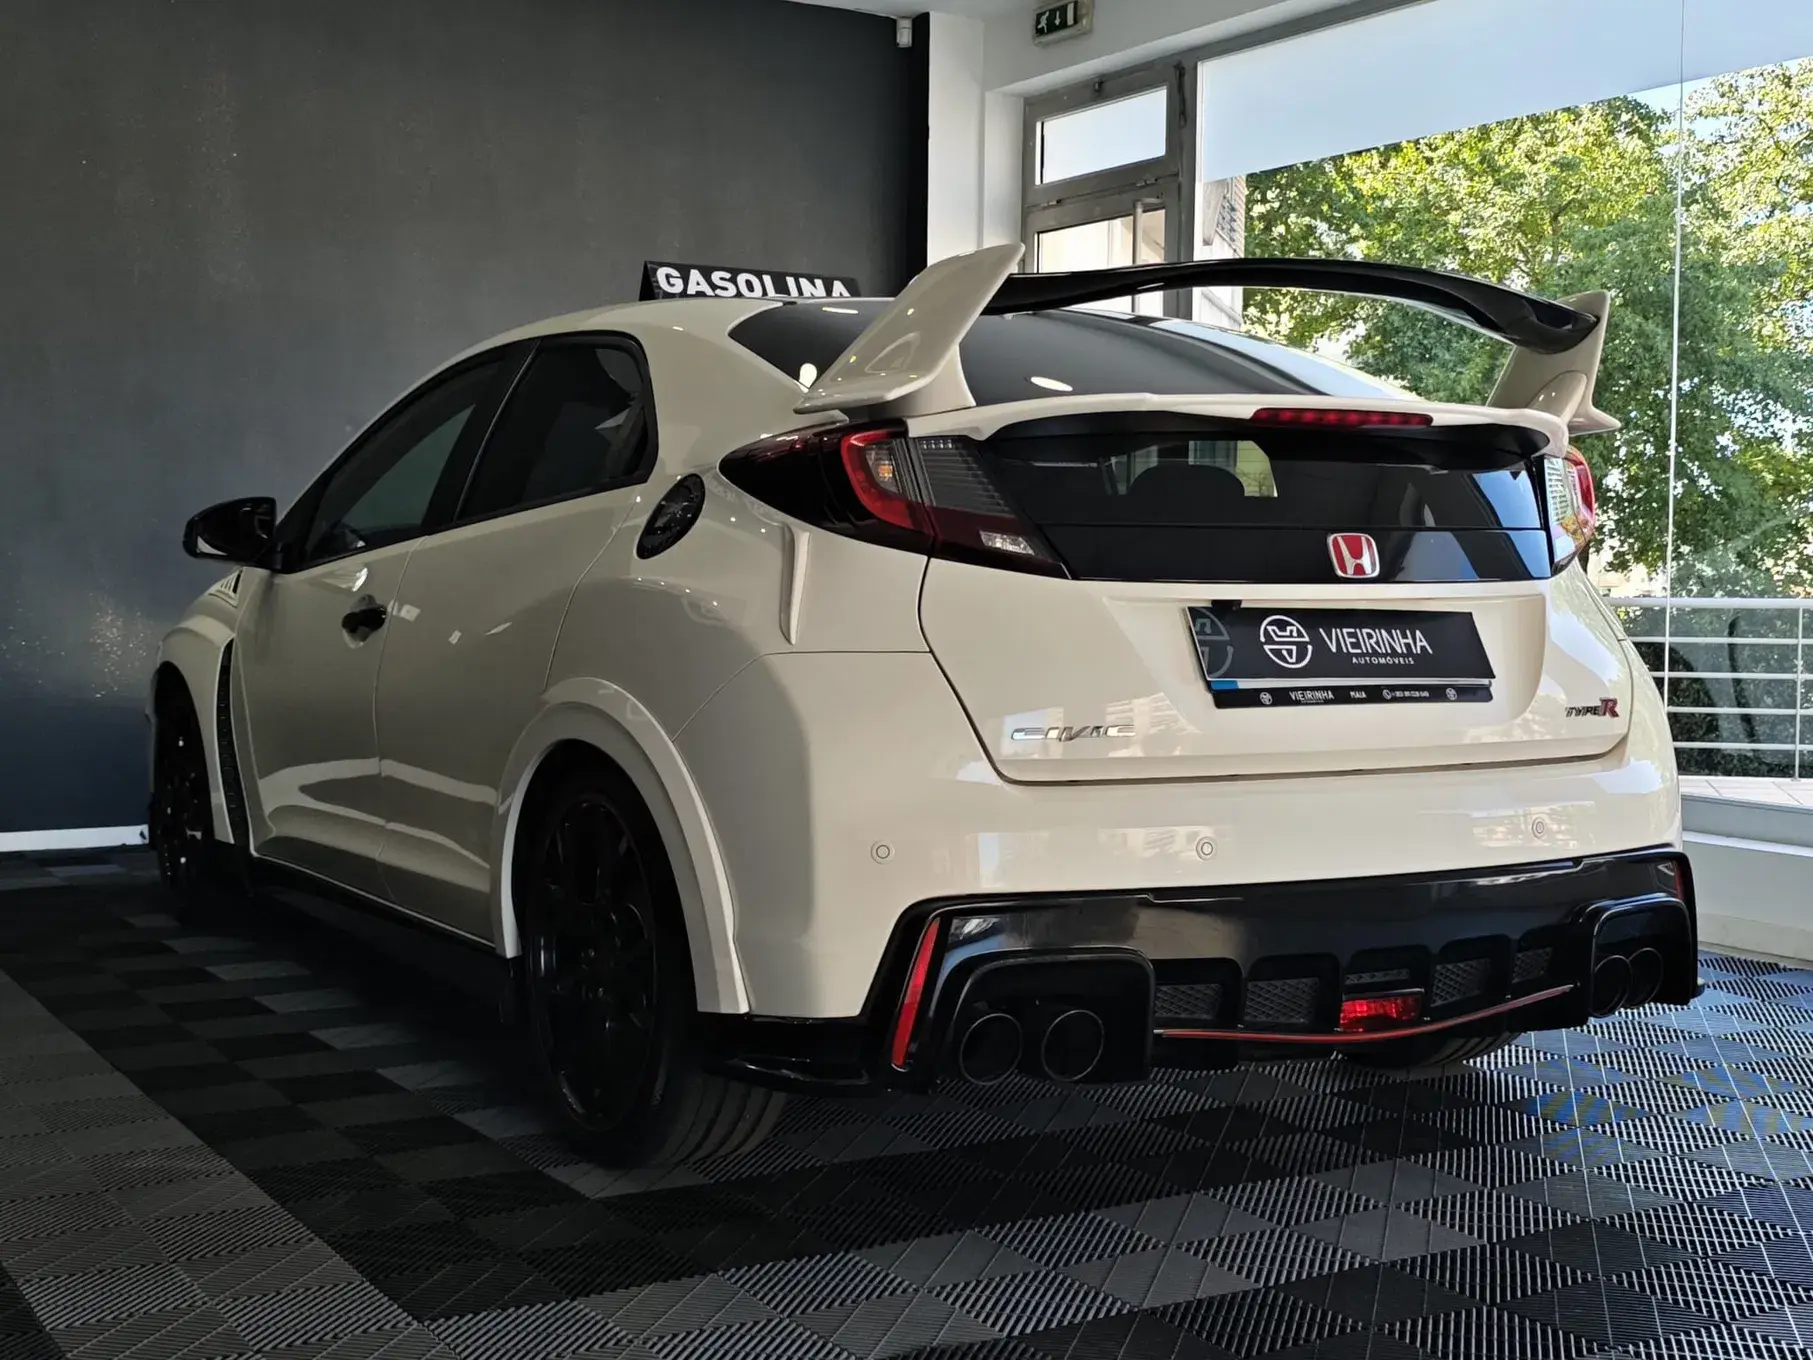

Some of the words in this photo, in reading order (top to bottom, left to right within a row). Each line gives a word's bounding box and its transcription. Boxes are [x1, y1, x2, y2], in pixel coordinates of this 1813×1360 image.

[656, 266, 852, 298] GASOLINA
[1319, 627, 1433, 655] VIEIRINHA
[1352, 656, 1415, 665] AUTOMÓVEIS
[1288, 690, 1335, 701] VIEIRINHA
[1011, 725, 1136, 742] CIVIC
